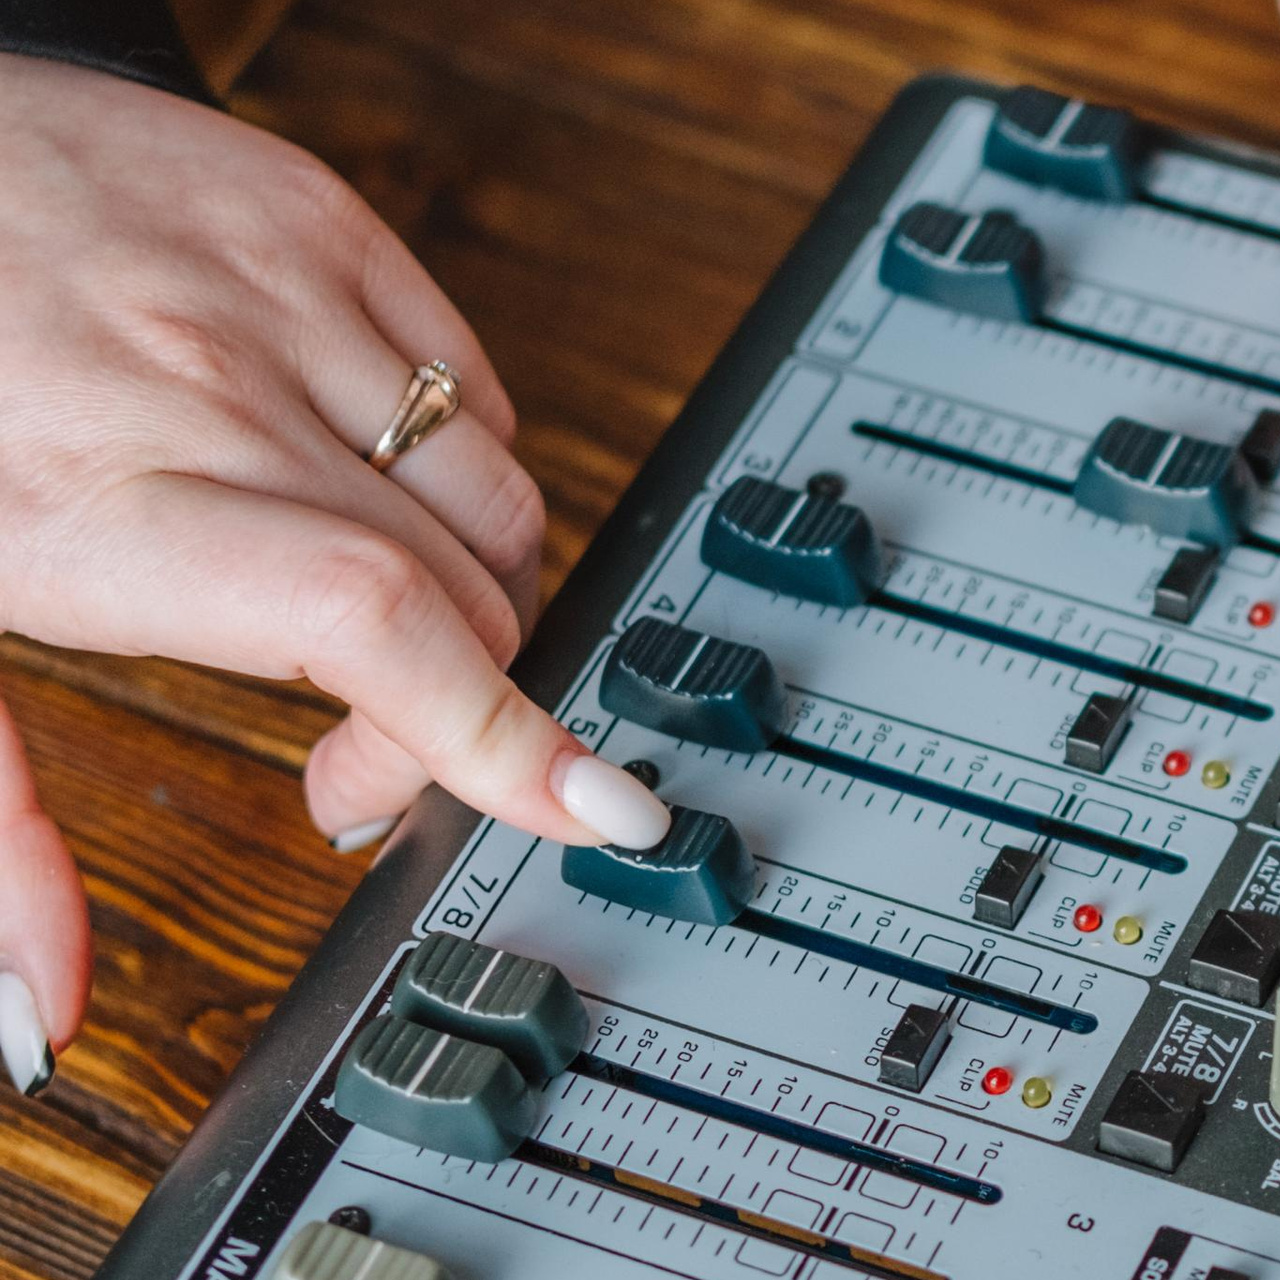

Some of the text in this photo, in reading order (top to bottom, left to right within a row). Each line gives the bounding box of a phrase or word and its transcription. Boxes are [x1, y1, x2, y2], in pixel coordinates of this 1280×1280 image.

[1057, 605, 1078, 625] 10
[1227, 594, 1249, 624] CLIP
[1253, 663, 1274, 683] 10
[798, 700, 817, 719] 30
[834, 711, 854, 732] 25
[873, 722, 893, 744] 20
[920, 739, 941, 758] 15
[1141, 741, 1165, 774] CLIP
[969, 754, 990, 773] 10
[1231, 765, 1262, 807] MUTE
[1168, 814, 1188, 833] 10
[778, 875, 799, 898] 20
[1240, 855, 1280, 912] ALT 3-4
[442, 873, 499, 929] 7/8
[827, 893, 848, 913] 15
[876, 909, 897, 929] 10
[1052, 896, 1077, 930] CLIP
[981, 937, 997, 950] 0
[1144, 921, 1177, 964] MUTE
[1079, 971, 1099, 991] 10
[598, 1015, 619, 1037] 30
[637, 1027, 660, 1051] 25
[1152, 1014, 1194, 1074] ALT 3-4
[1170, 1023, 1213, 1077] MUTE
[677, 1040, 699, 1063] 20
[1191, 1033, 1239, 1085] 7/8
[727, 1058, 749, 1079] 15
[959, 1057, 985, 1092] CLIP
[777, 1074, 799, 1096] 10
[885, 1105, 900, 1117] 0
[1052, 1083, 1087, 1128] MUTE
[1231, 1097, 1249, 1111] R
[983, 1140, 1005, 1160] 10
[1066, 1213, 1096, 1233] 3
